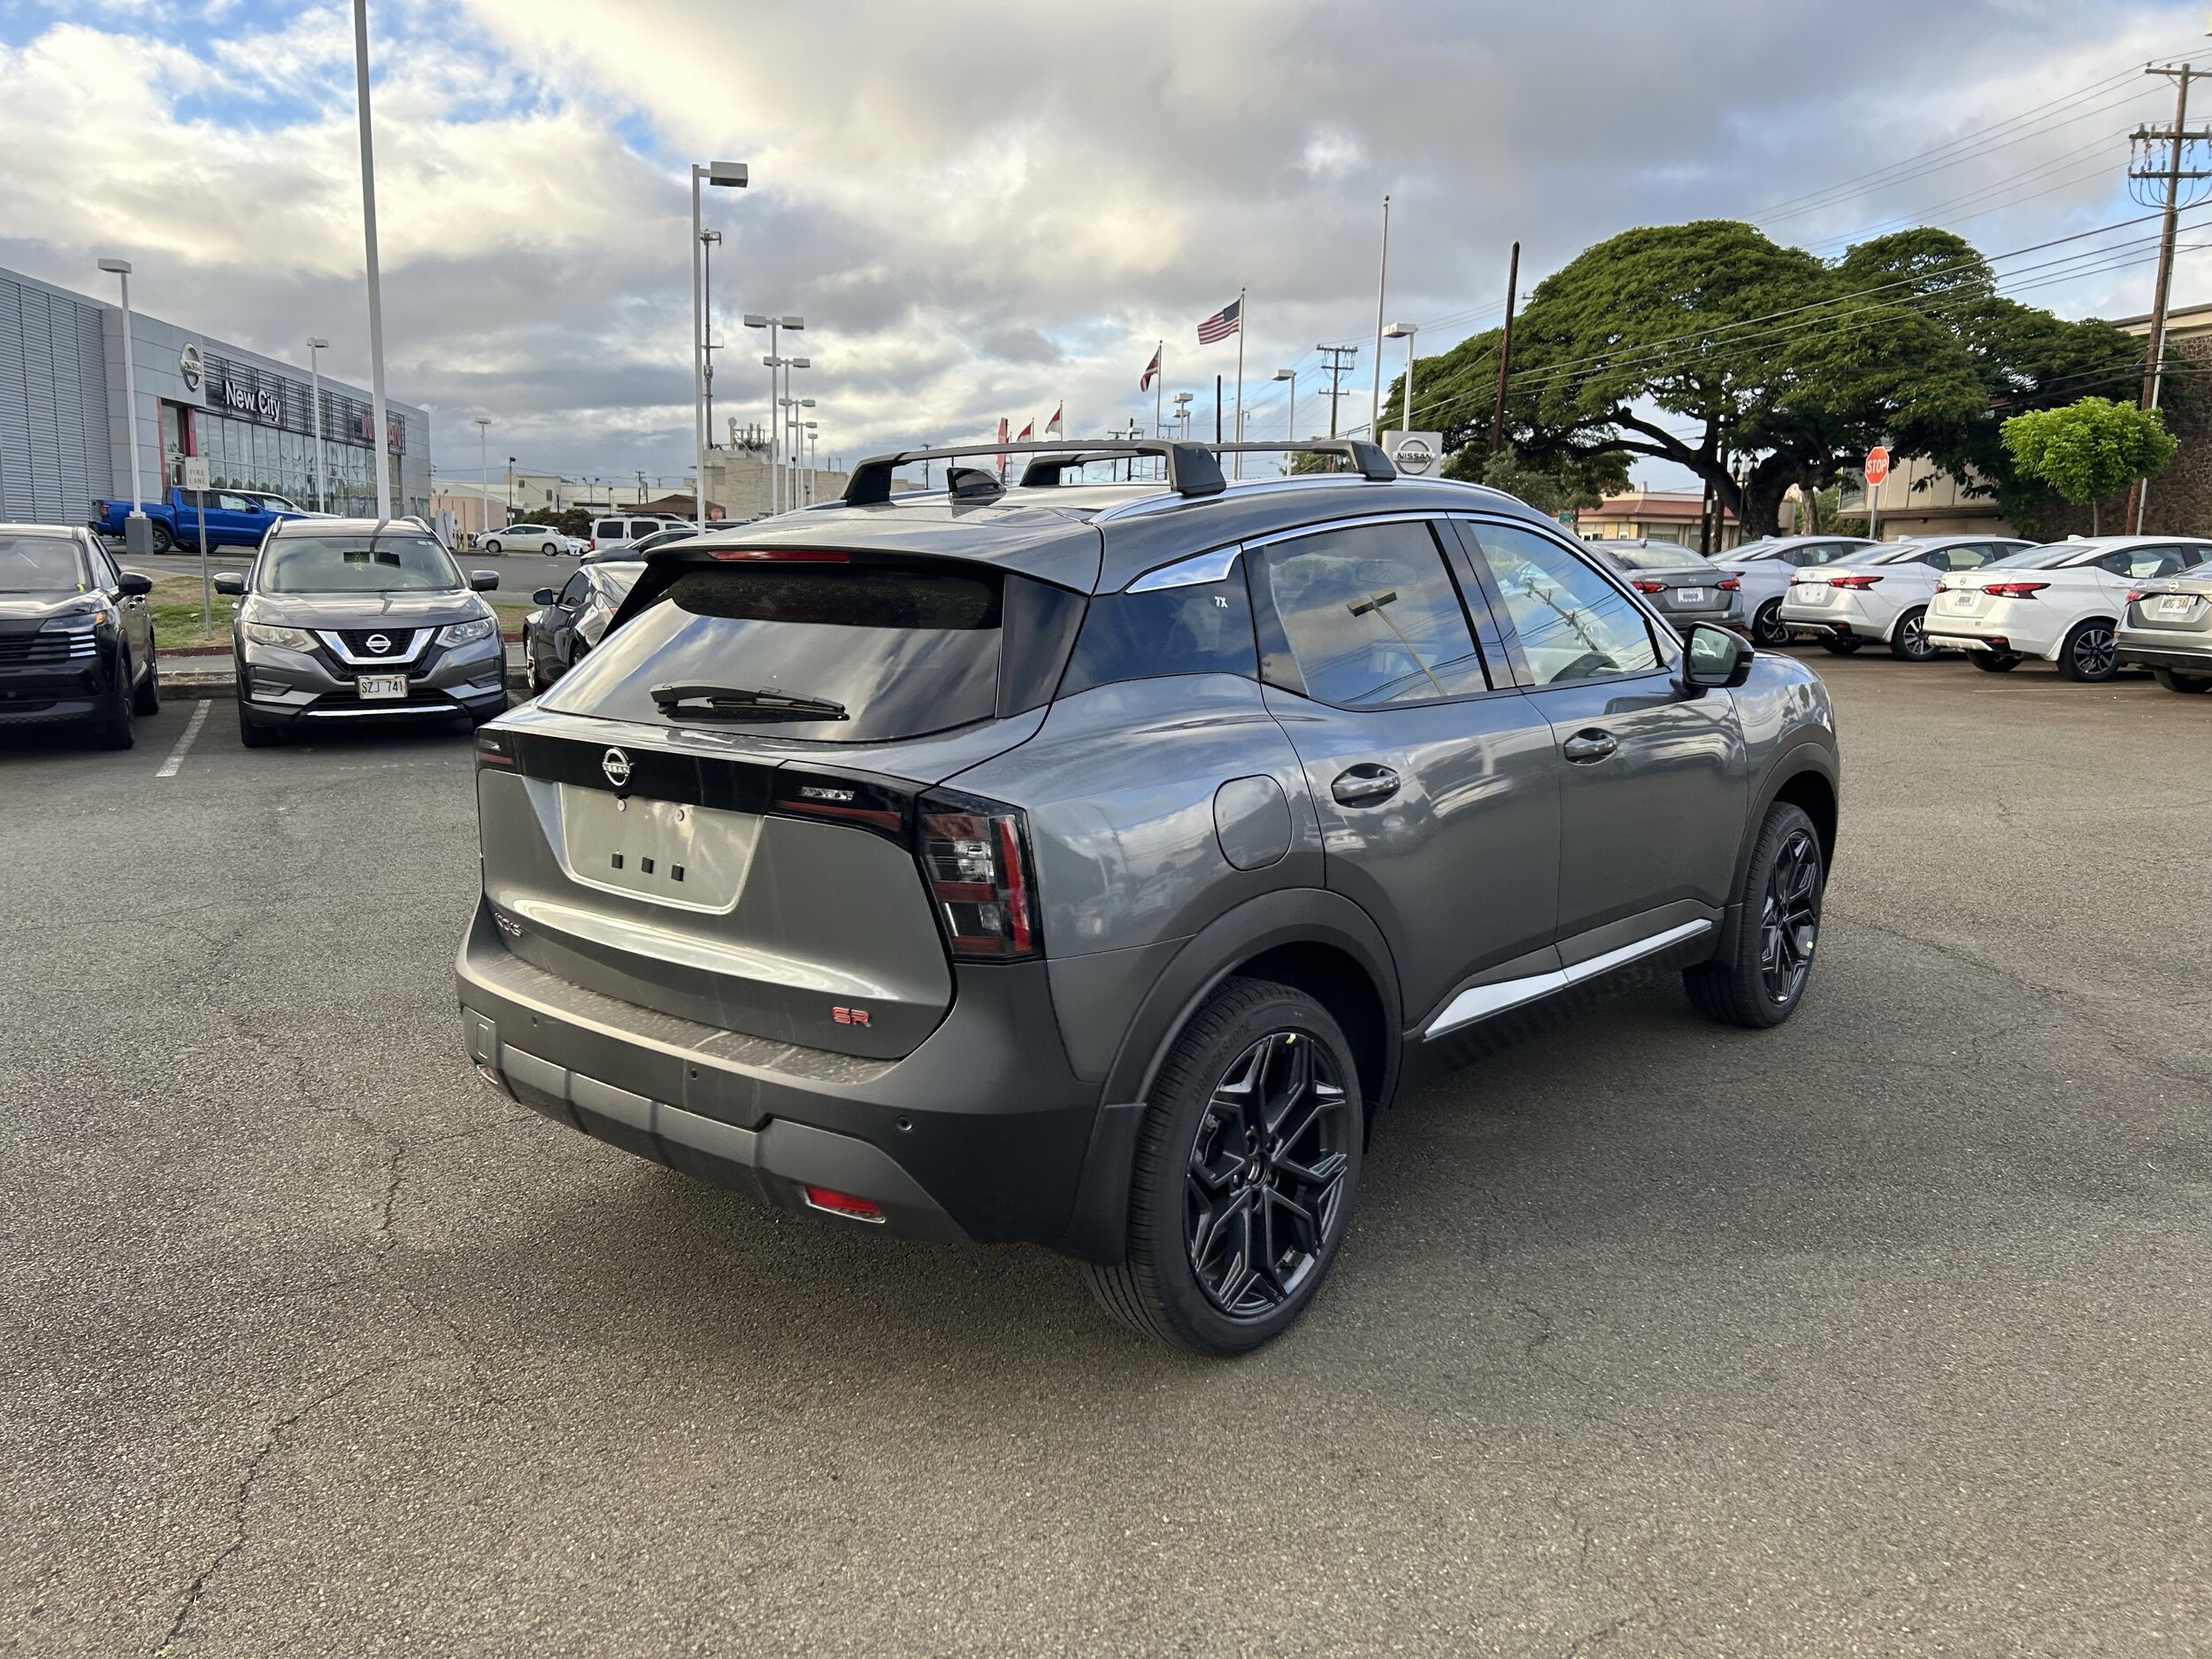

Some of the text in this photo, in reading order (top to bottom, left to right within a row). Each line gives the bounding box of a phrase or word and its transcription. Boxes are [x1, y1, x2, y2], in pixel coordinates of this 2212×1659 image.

[224, 380, 280, 422] New City
[1867, 459, 1887, 474] STOP
[361, 680, 403, 694] SZJ 741
[603, 763, 630, 774] NSSAN
[833, 1006, 872, 1027] SR
